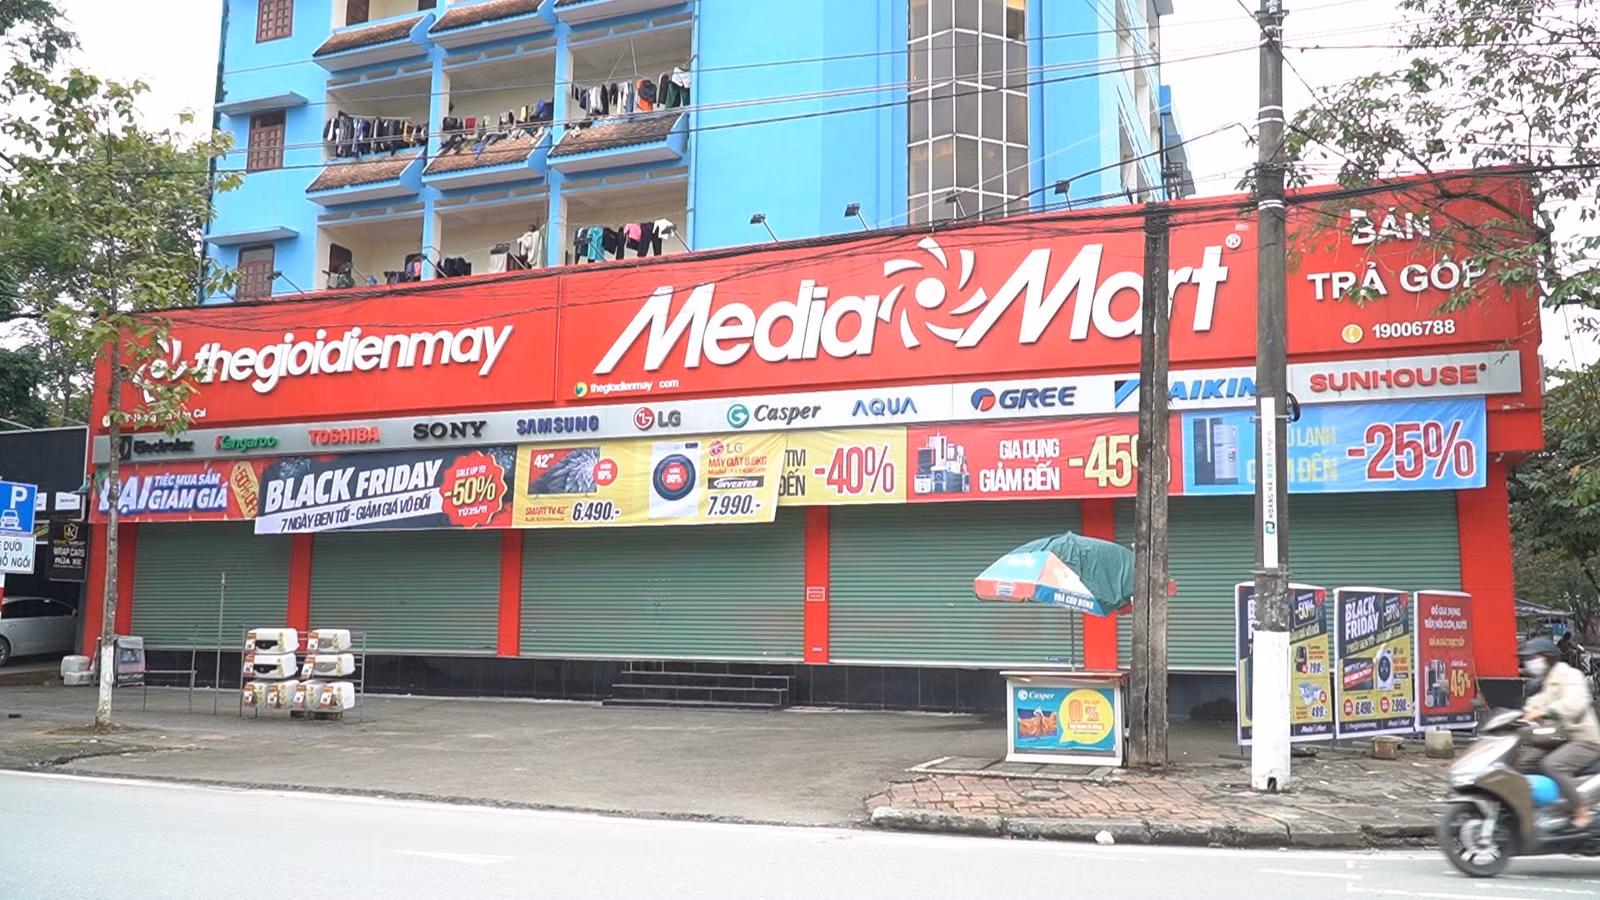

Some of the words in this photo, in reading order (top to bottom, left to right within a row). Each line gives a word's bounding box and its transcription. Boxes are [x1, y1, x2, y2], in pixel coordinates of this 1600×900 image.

[1350, 207, 1431, 245] BÁN
[1307, 261, 1388, 300] TRẢ
[1400, 254, 1486, 292] GÓP
[592, 279, 880, 375] Media
[1372, 319, 1455, 338] 19006788
[195, 325, 513, 393] thegioidienmay
[1168, 377, 1257, 400] AIKIN
[1309, 364, 1478, 393] SUNHOUSE
[852, 397, 918, 417] AQUA
[999, 385, 1077, 410] GREE
[516, 415, 599, 435] SAMSUNG
[658, 410, 681, 427] LG
[753, 404, 821, 425] Casper
[309, 425, 381, 446] TOSHIBA
[412, 420, 488, 441] SONY
[726, 443, 743, 453] LG
[1000, 440, 1022, 459] GIA
[1023, 438, 1060, 462] DỤNG
[1347, 419, 1476, 481] -25%
[708, 457, 726, 467] MÁY
[815, 446, 895, 494] -40%
[1298, 450, 1338, 482] ĐẾN
[175, 474, 198, 485] MUA
[265, 467, 355, 513] BLACK
[355, 459, 444, 498] FRIDAY
[716, 480, 758, 489] INVERTER
[979, 462, 1022, 492] GIẢM
[1023, 461, 1061, 491] ĐẾN
[10, 486, 28, 509] P
[148, 485, 196, 509] GIẢM
[197, 481, 228, 509] GIÁ
[443, 474, 496, 506] -50%
[281, 518, 287, 532] 7
[287, 513, 314, 532] NGÀY
[314, 512, 333, 527] ĐEN
[334, 506, 350, 525] TỐI
[356, 502, 382, 521] GIẢM
[382, 500, 398, 517] GIÁ
[398, 496, 414, 514] VÔ
[525, 507, 546, 515] SMART
[547, 506, 556, 514] TV
[573, 501, 620, 521] 6.490.-
[707, 494, 761, 515] 7.990.-
[1345, 595, 1375, 622] BLACK
[1345, 612, 1379, 640] FRIDAY
[1451, 669, 1471, 697] 45%
[1029, 691, 1055, 701] Casper
